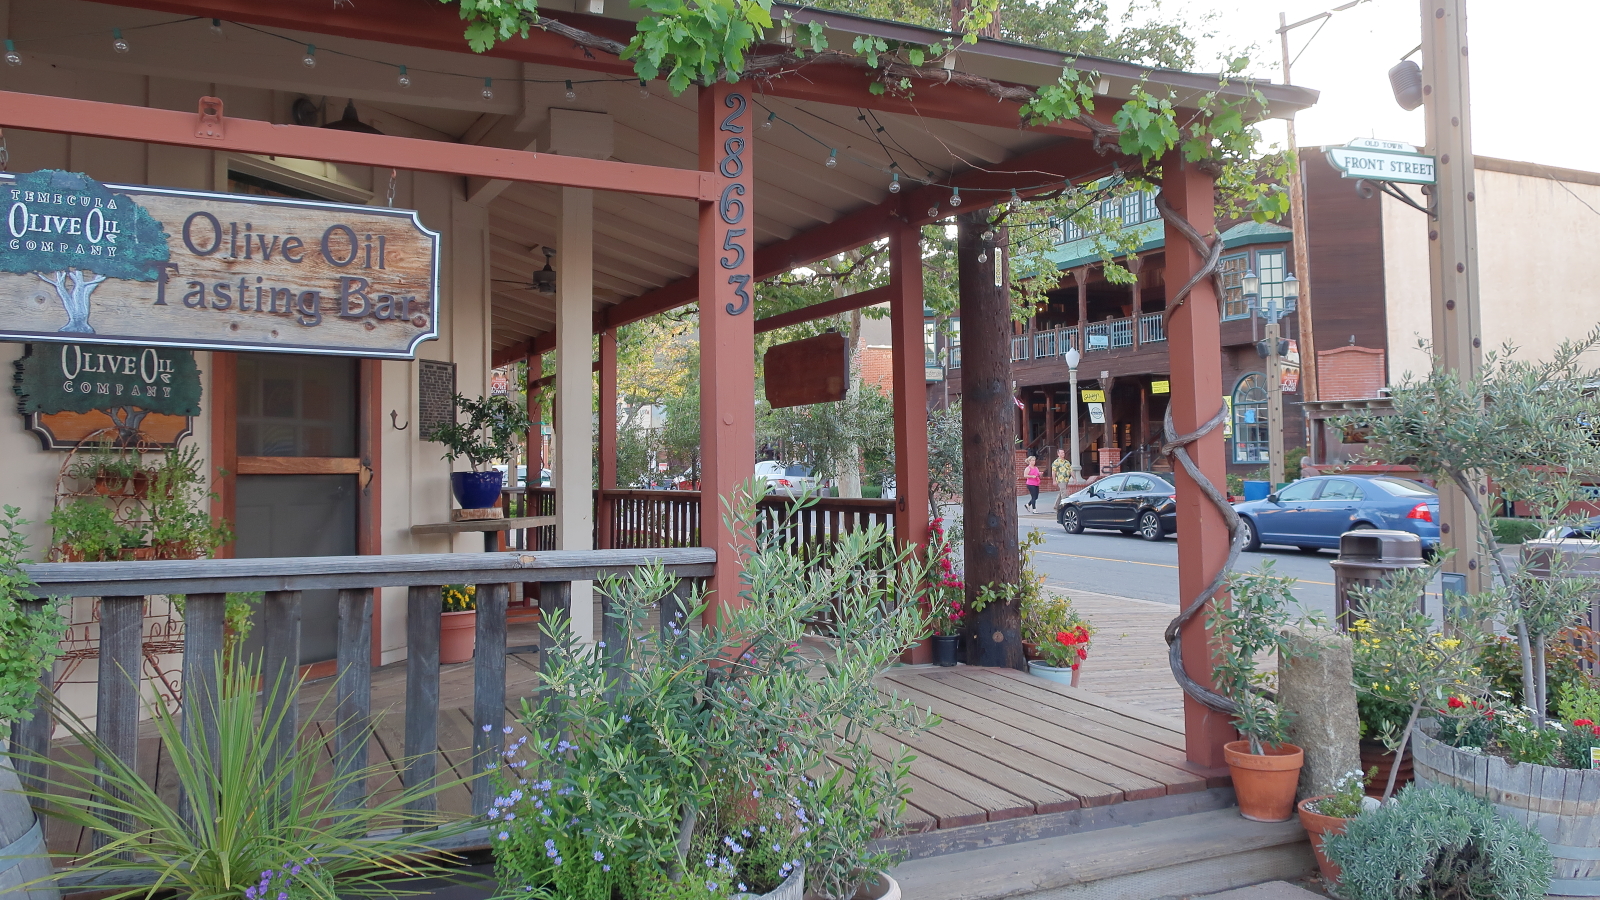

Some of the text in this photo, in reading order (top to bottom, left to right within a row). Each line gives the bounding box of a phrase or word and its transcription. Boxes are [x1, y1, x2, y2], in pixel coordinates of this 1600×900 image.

[1364, 140, 1403, 150] OLD TOWN
[1344, 156, 1434, 176] FRONT STREET
[10, 189, 118, 210] TEMECULA
[719, 92, 751, 316] 28653
[9, 239, 118, 257] COMPANY
[182, 211, 386, 270] Olive Oil
[150, 261, 416, 327] Tasting Bar
[63, 380, 171, 398] COMPANY
